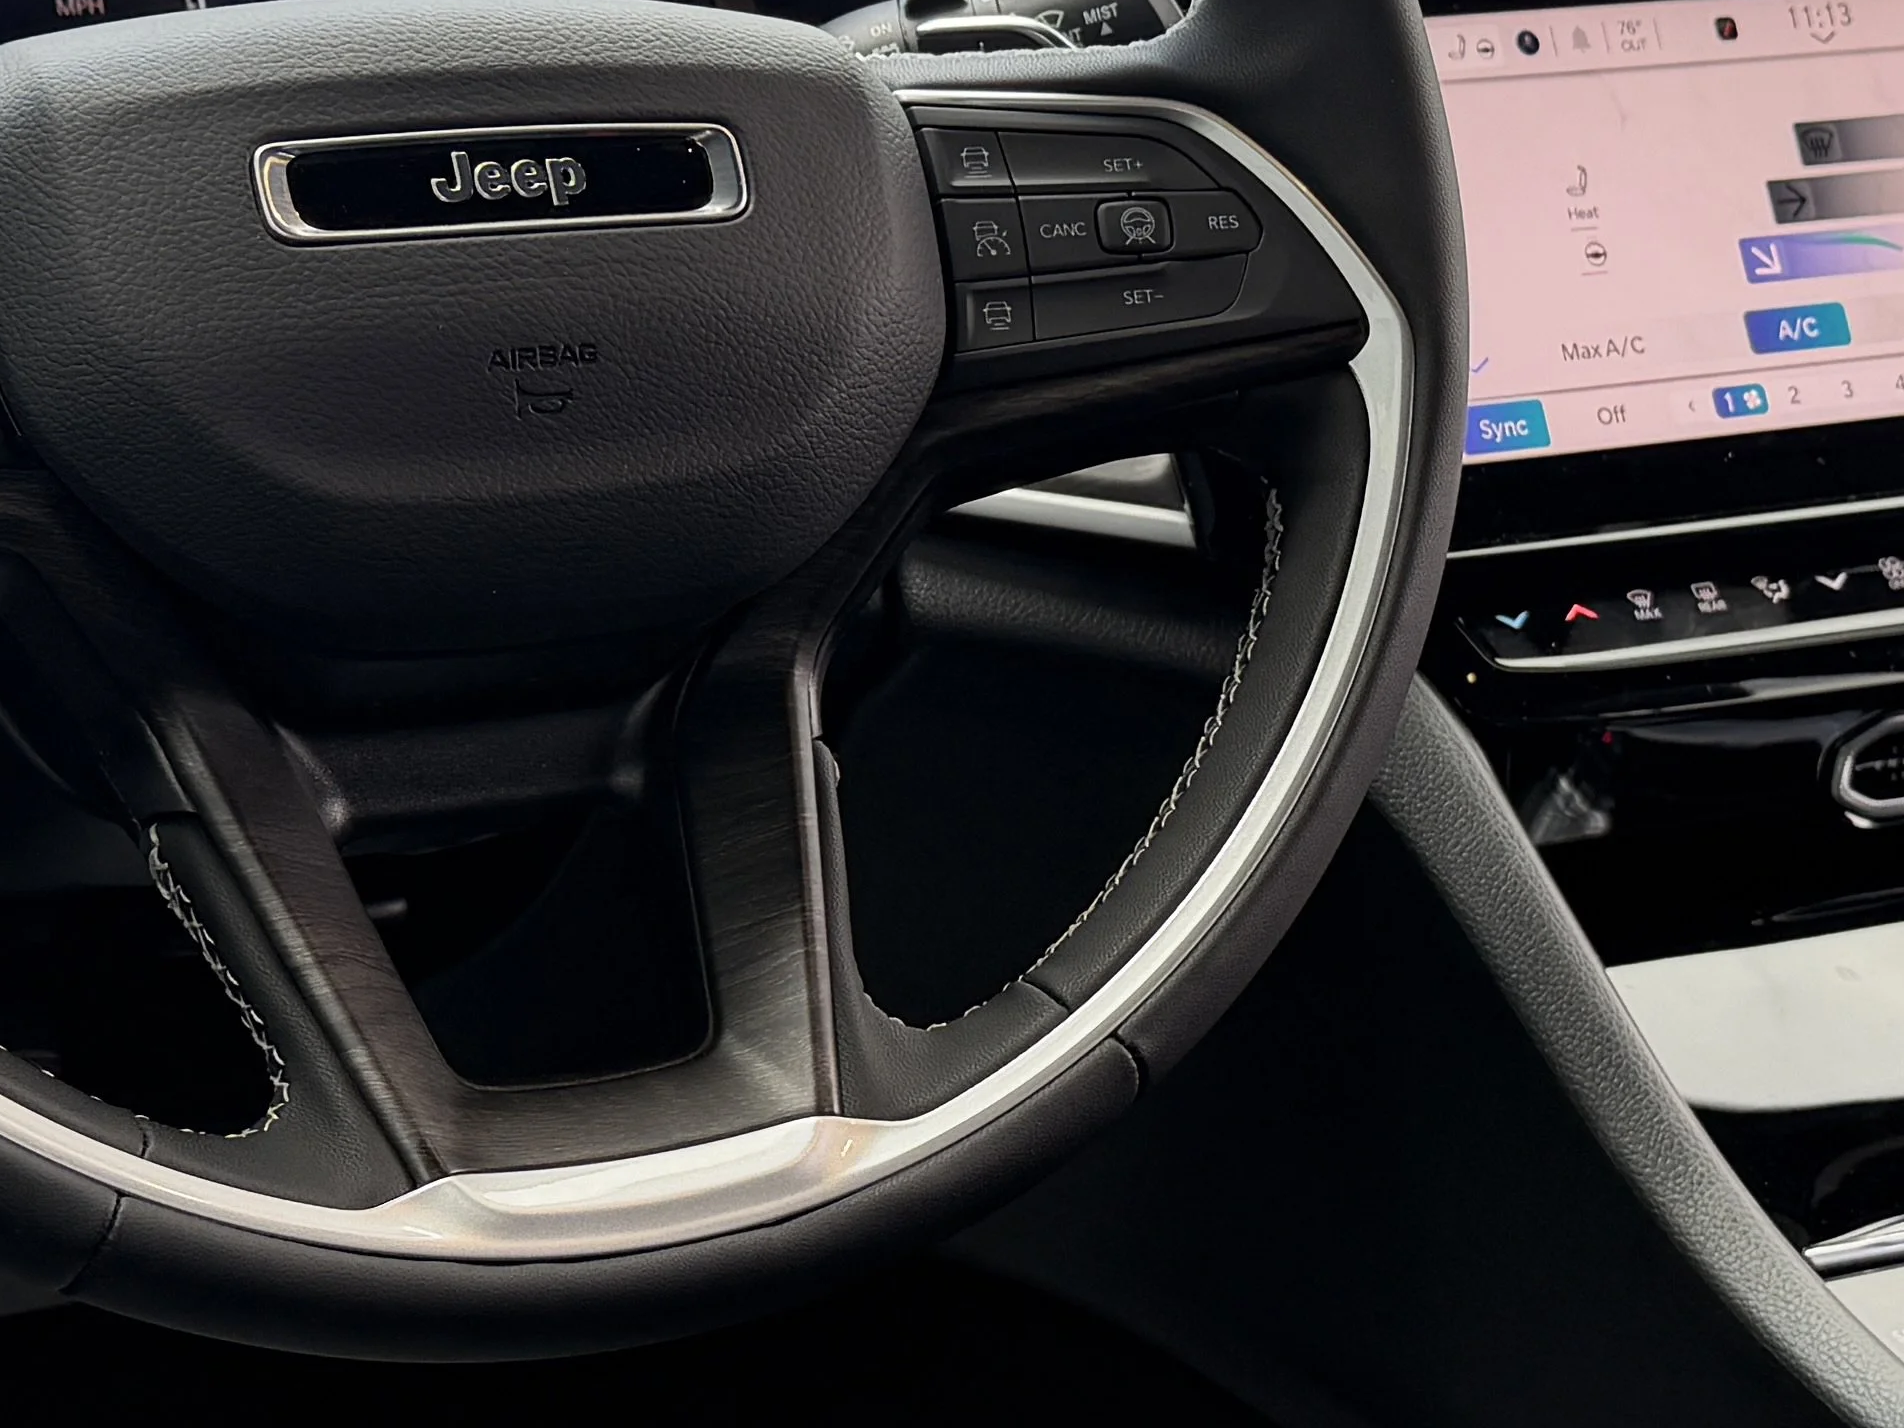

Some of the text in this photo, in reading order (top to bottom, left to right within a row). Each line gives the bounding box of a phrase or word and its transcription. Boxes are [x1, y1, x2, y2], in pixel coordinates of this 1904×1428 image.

[1082, 2, 1119, 26] MIST
[1787, 2, 1853, 31] 11:13
[870, 23, 893, 38] ON
[1102, 156, 1145, 173] SET+
[430, 150, 588, 207] Jeep
[1207, 215, 1240, 231] RES
[1566, 205, 1600, 223] Heat
[1038, 221, 1088, 240] CANC
[1777, 318, 1820, 341] A/C
[487, 341, 597, 373] AIRBAG
[1561, 334, 1647, 364] Max A/C
[1597, 404, 1628, 427] Off
[1723, 392, 1736, 413] 1
[1787, 385, 1802, 405] 2
[1840, 380, 1854, 400] 3
[1477, 417, 1530, 443] Sync
[1633, 606, 1663, 621] MAX
